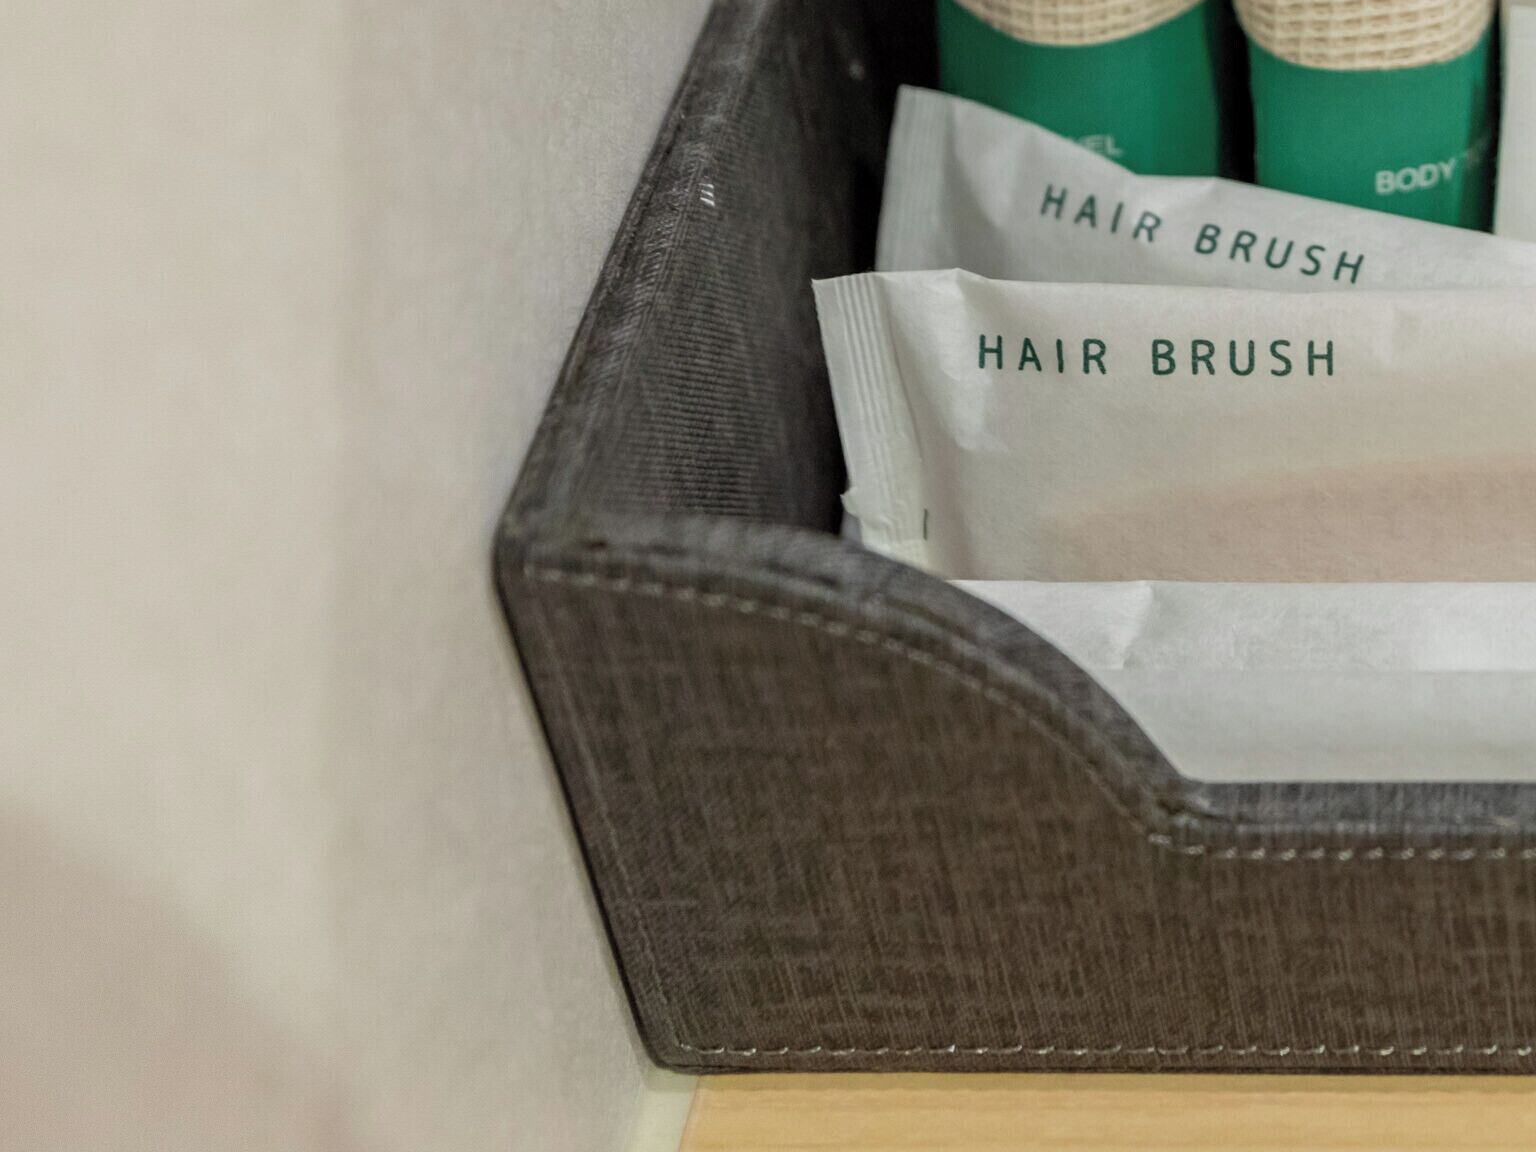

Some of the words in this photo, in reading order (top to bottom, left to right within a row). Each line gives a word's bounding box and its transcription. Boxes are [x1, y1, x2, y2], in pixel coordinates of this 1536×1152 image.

[1374, 156, 1458, 196] BODY
[1040, 183, 1163, 243] HAIR
[1194, 223, 1365, 285] BRUSH
[977, 333, 1108, 376] HAIR
[1150, 338, 1335, 377] BRUSH
